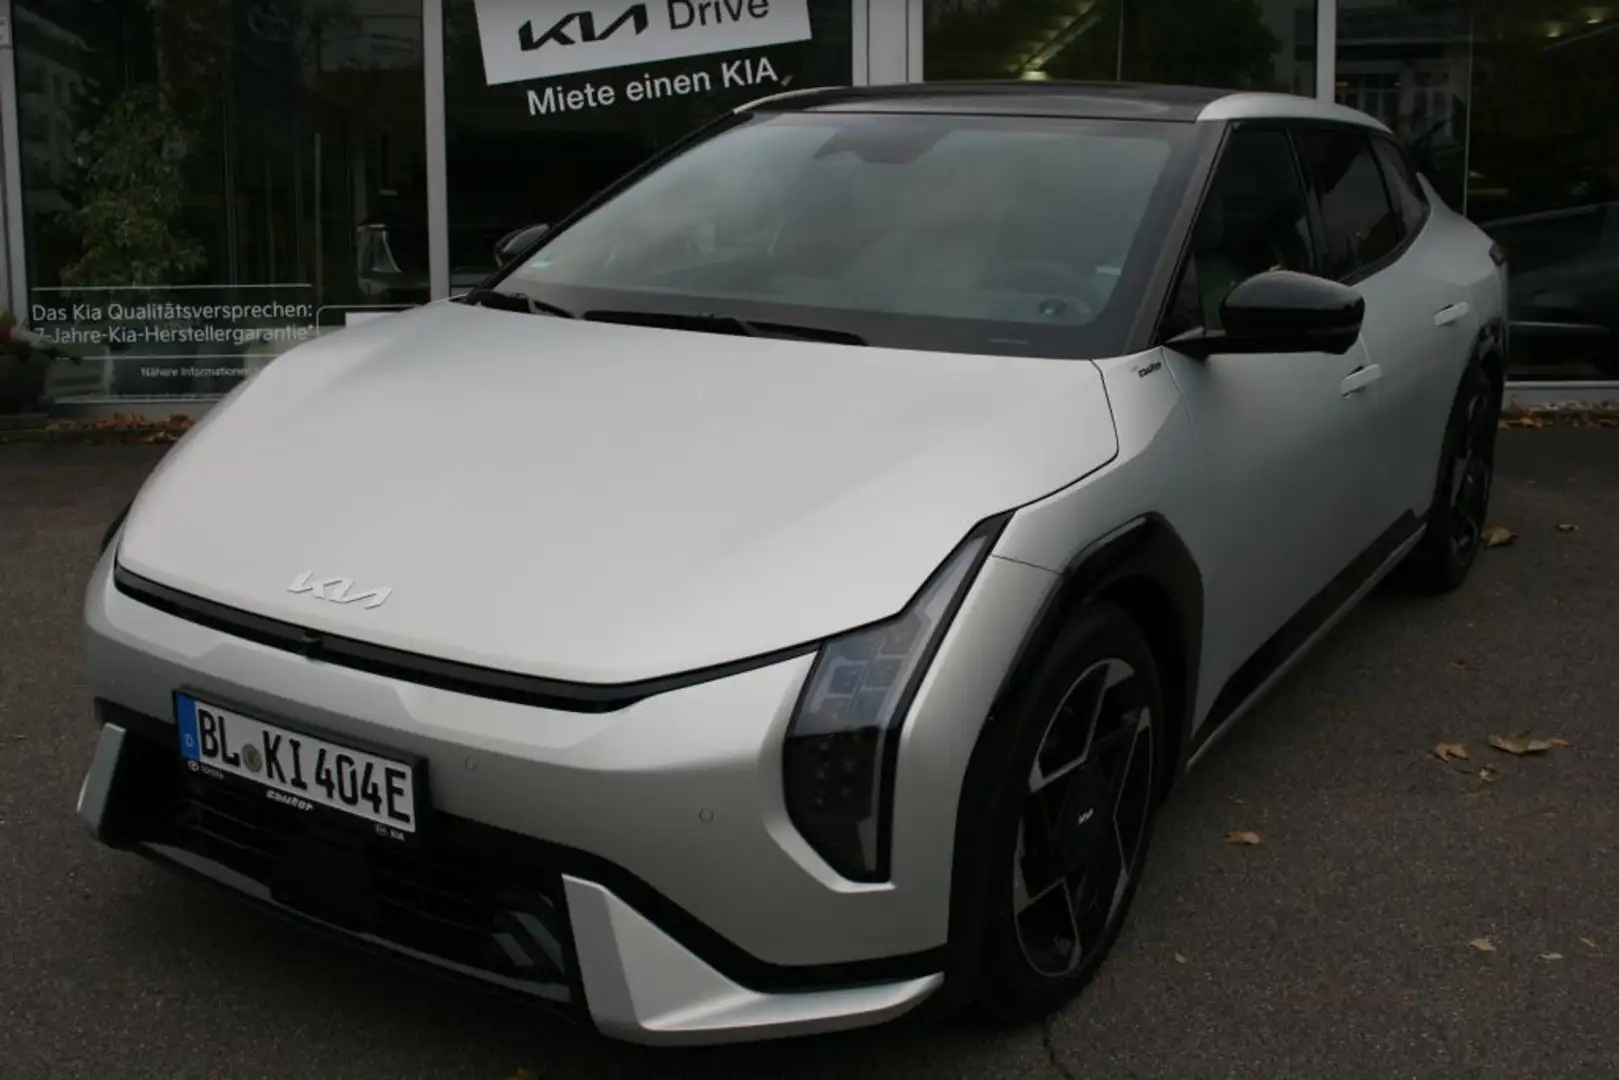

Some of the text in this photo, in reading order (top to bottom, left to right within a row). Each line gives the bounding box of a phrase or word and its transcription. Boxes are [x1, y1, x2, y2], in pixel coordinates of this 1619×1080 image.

[518, 0, 769, 51] KIA Drive
[526, 57, 778, 116] Miete einen KIA
[32, 300, 313, 323] Das Kia Qualitätsversprechen:
[286, 570, 393, 610] KIA
[198, 708, 411, 824] BL KI 404E
